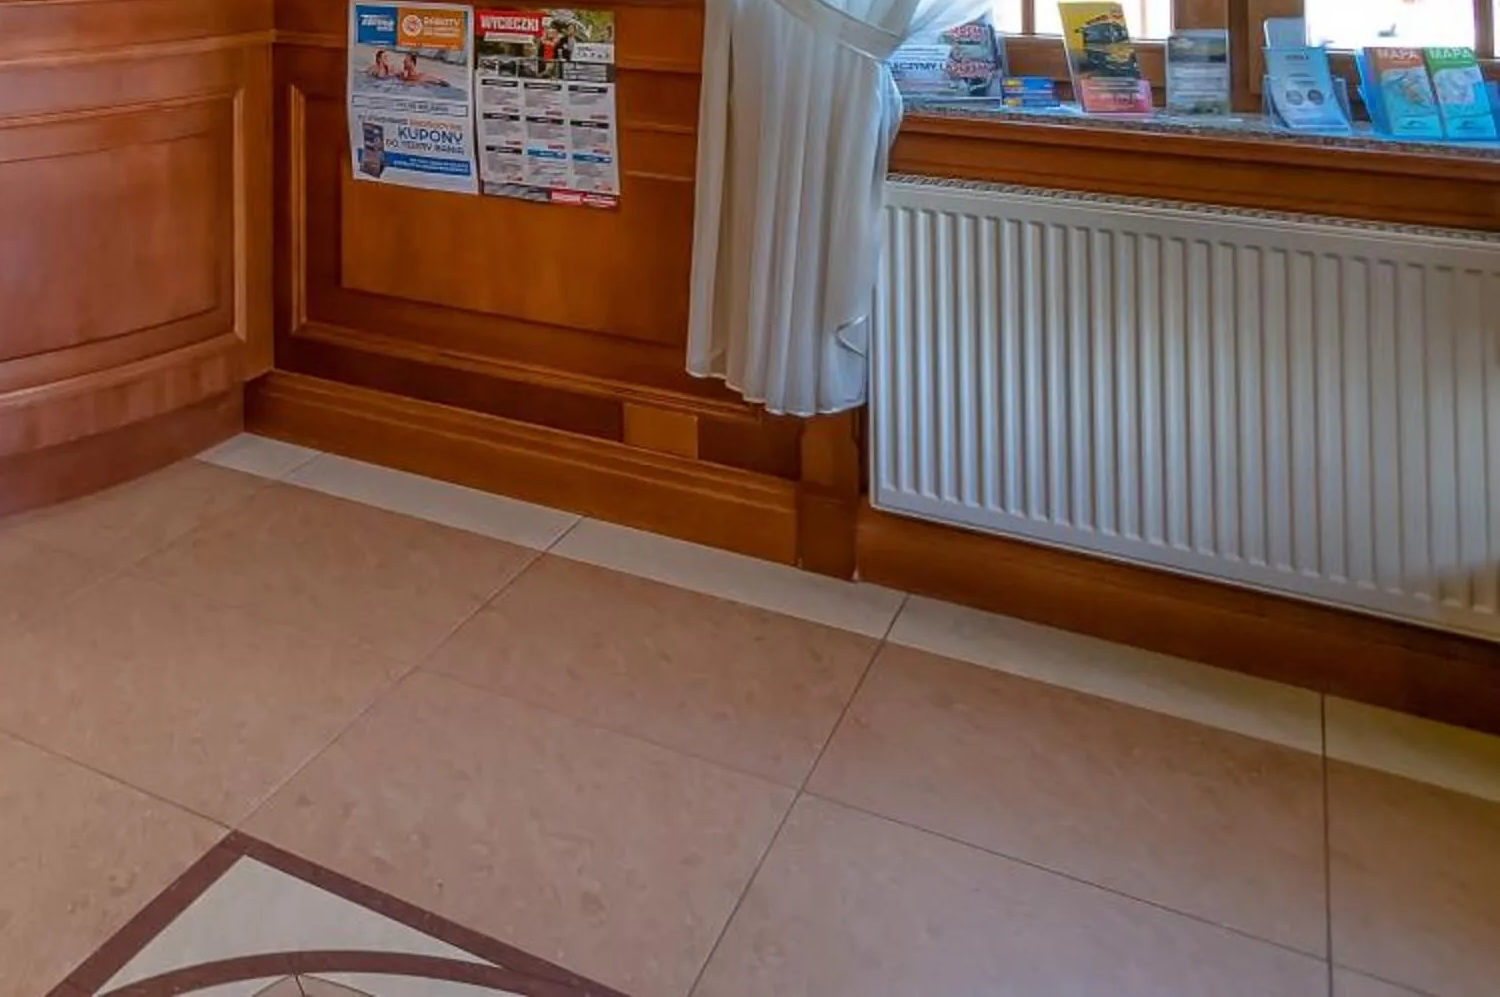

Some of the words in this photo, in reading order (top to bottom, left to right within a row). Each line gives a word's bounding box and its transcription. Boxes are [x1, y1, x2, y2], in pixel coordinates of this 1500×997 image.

[481, 15, 539, 31] WYCIECZKI
[1429, 46, 1473, 59] MAPA
[398, 125, 463, 143] KUPONY
